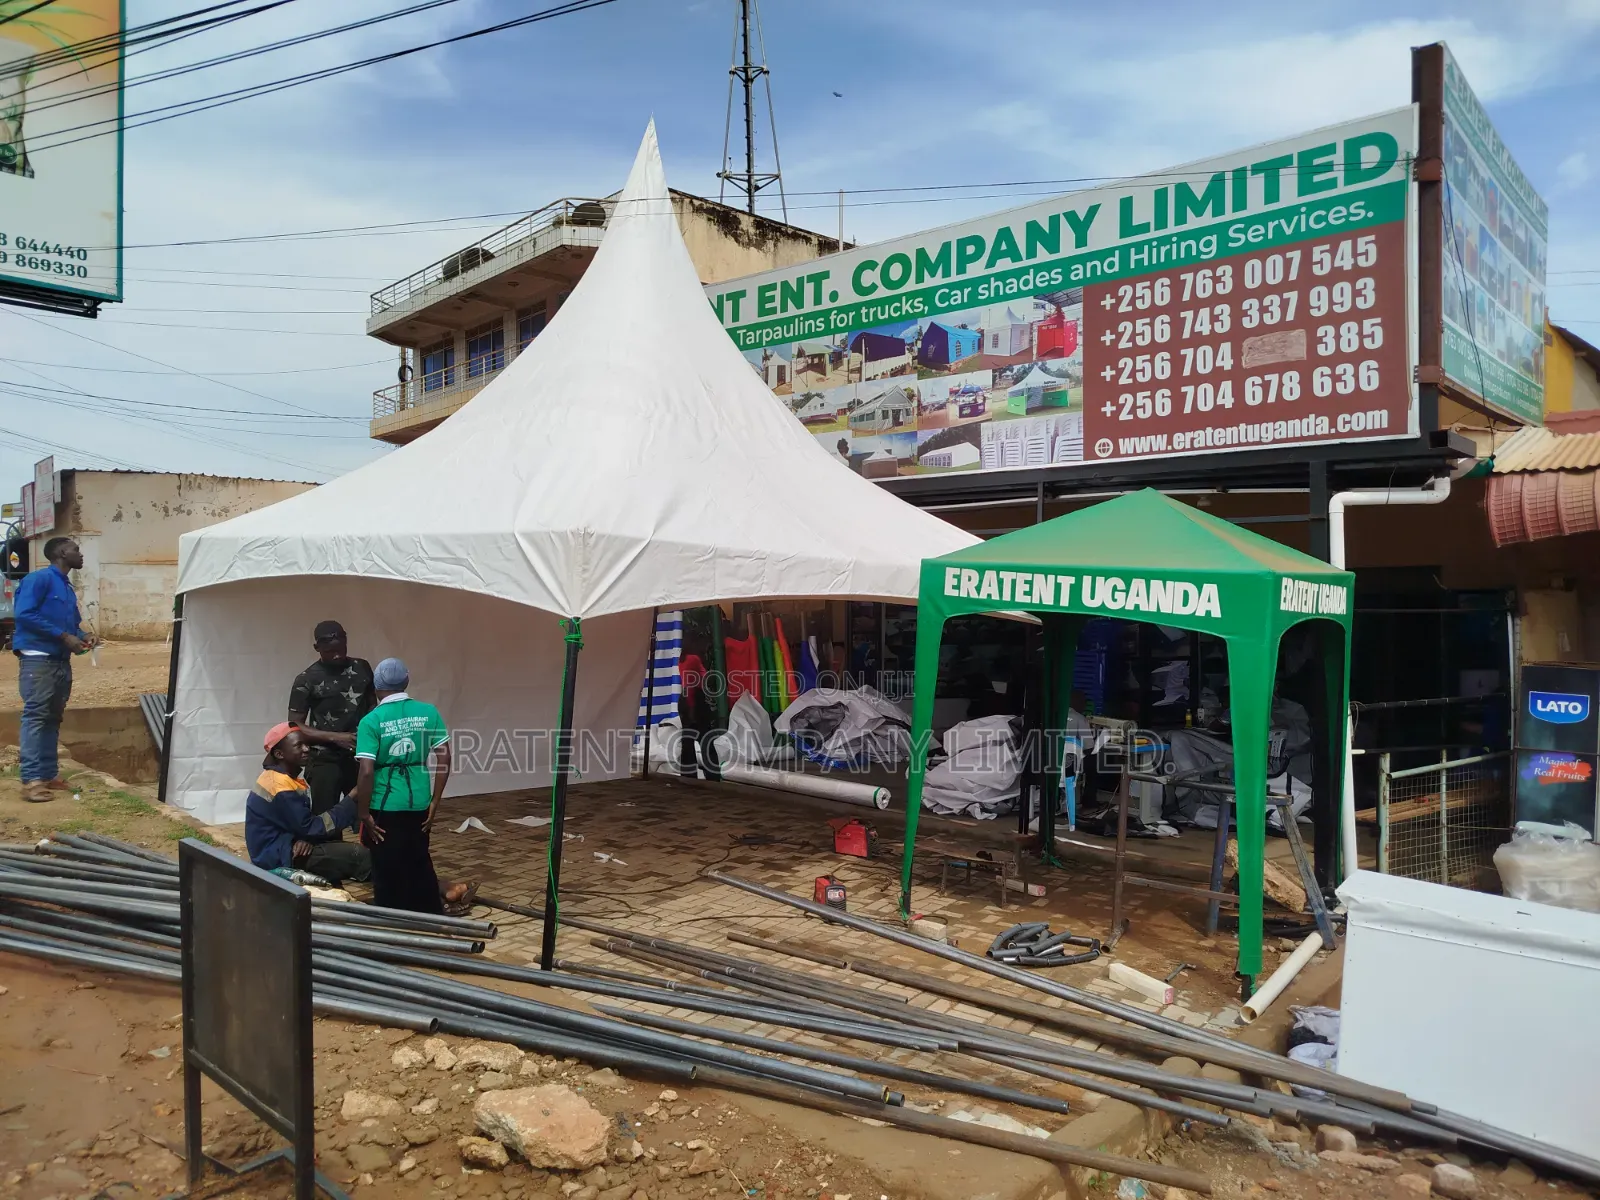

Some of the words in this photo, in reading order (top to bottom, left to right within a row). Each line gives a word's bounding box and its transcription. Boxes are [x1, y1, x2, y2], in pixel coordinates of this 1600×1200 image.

[15, 236, 88, 261] 644440
[757, 270, 839, 318] ENT.
[852, 203, 1102, 297] COMPANY
[1119, 131, 1399, 240] LIMITED
[15, 254, 88, 278] 869330
[737, 317, 825, 347] Tarpaulins
[829, 309, 855, 328] for
[861, 295, 929, 322] trucks,
[934, 286, 968, 309] Car
[977, 267, 1063, 298] shades
[1070, 250, 1120, 281] and
[1130, 234, 1218, 269] Hiring
[1228, 201, 1375, 248] Services.
[1100, 277, 1171, 313] +256
[1180, 264, 1233, 302] 763
[1244, 250, 1302, 289] 007
[1312, 235, 1377, 276] 545
[1100, 315, 1171, 349] +256
[1180, 304, 1232, 339] 743
[1241, 291, 1299, 329] 337
[1309, 277, 1376, 317] 993
[1101, 352, 1171, 385] +256
[1180, 342, 1233, 377] 704
[1316, 317, 1384, 356] 385
[1101, 389, 1172, 420] +256
[1181, 381, 1234, 414] 704
[1244, 371, 1301, 406] 678
[1312, 360, 1380, 398] 636
[1118, 409, 1389, 455] www.eratentuganda.com
[943, 566, 1076, 608] ERATENT
[1080, 576, 1222, 618] UGANDA
[1279, 576, 1318, 614] ERATENT
[1317, 582, 1348, 616] UGANDA
[1536, 699, 1583, 715] LATO
[1533, 766, 1555, 778] Real
[1557, 769, 1586, 781] Fruits
[1538, 756, 1568, 768] Magic
[1569, 758, 1583, 770] of
